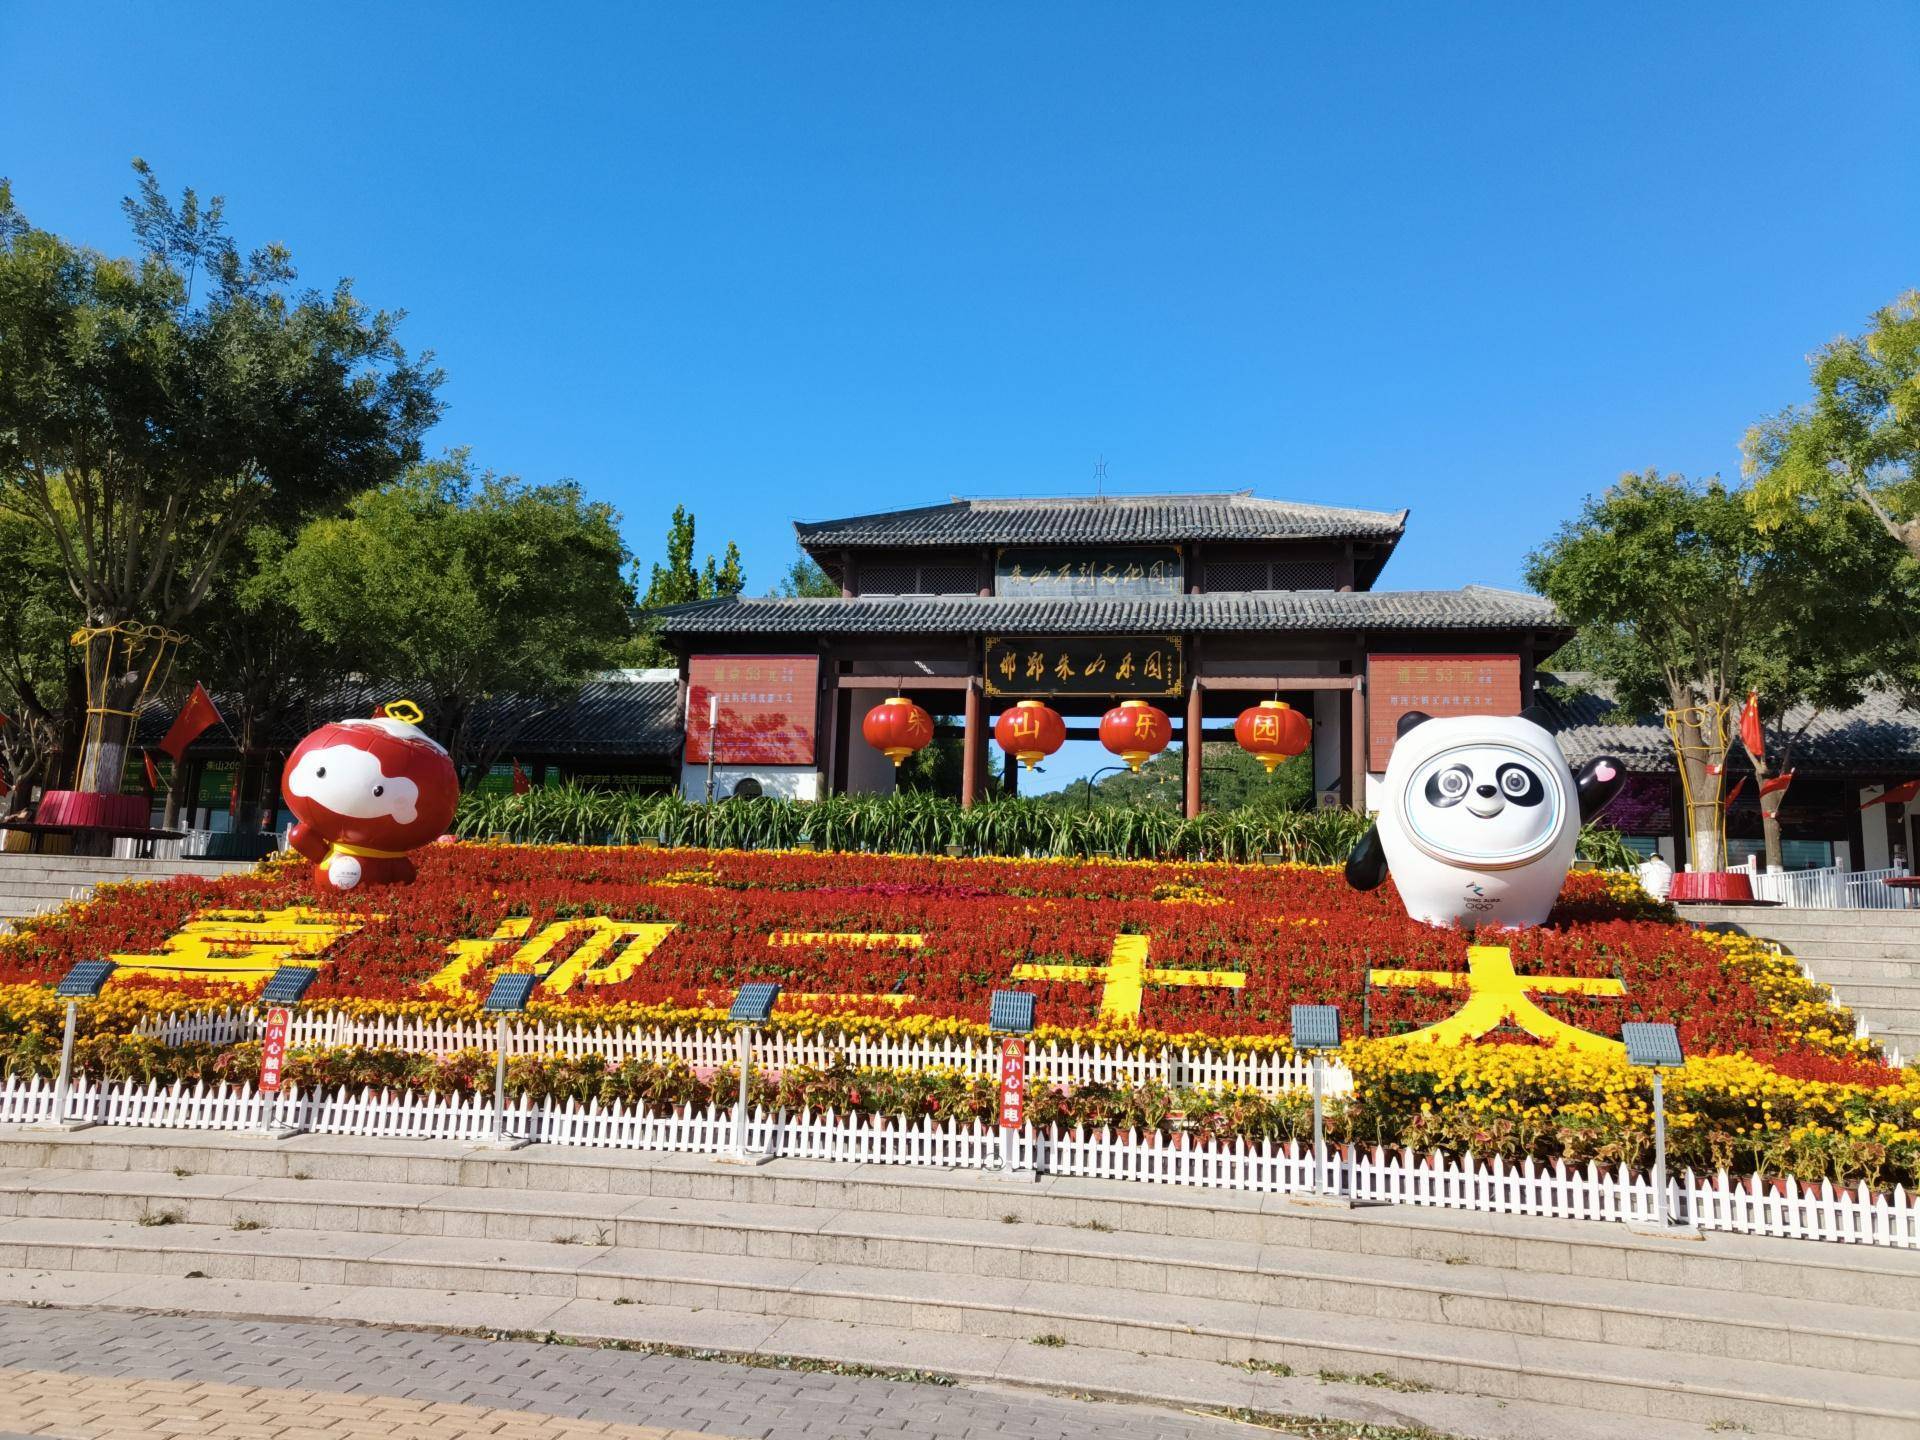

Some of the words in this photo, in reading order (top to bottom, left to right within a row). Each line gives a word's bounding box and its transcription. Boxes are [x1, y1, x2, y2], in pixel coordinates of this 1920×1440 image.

[999, 650, 1164, 682] 邯郸朱山乐园
[1435, 667, 1454, 683] 53
[906, 708, 929, 737] 朱
[1013, 711, 1041, 740] 山
[1134, 713, 1158, 741] 乐
[1253, 714, 1279, 746] 园
[263, 1028, 283, 1085] 小心触电
[1003, 1058, 1021, 1122] 小心触电
